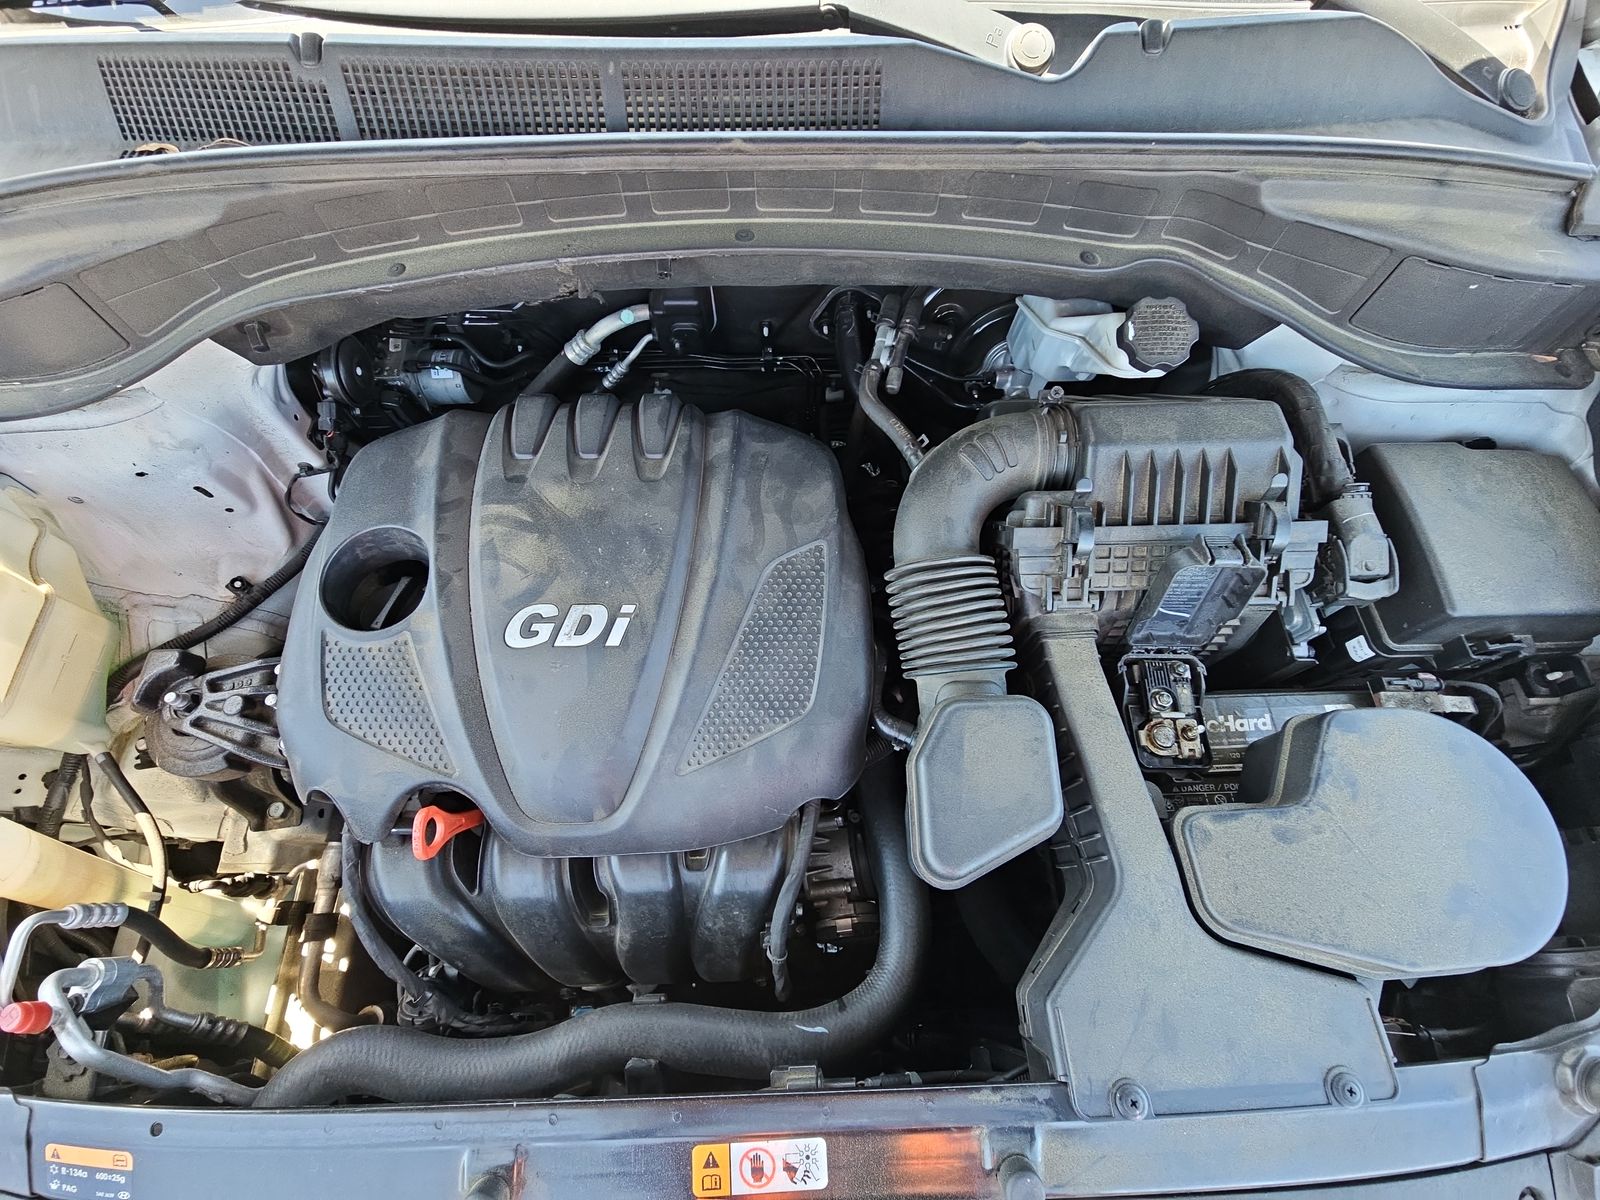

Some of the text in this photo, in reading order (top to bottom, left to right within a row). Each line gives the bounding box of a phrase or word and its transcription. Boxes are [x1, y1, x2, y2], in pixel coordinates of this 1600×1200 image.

[504, 603, 637, 649] GDi
[1181, 784, 1216, 792] DANGER
[62, 1184, 77, 1193] PAG
